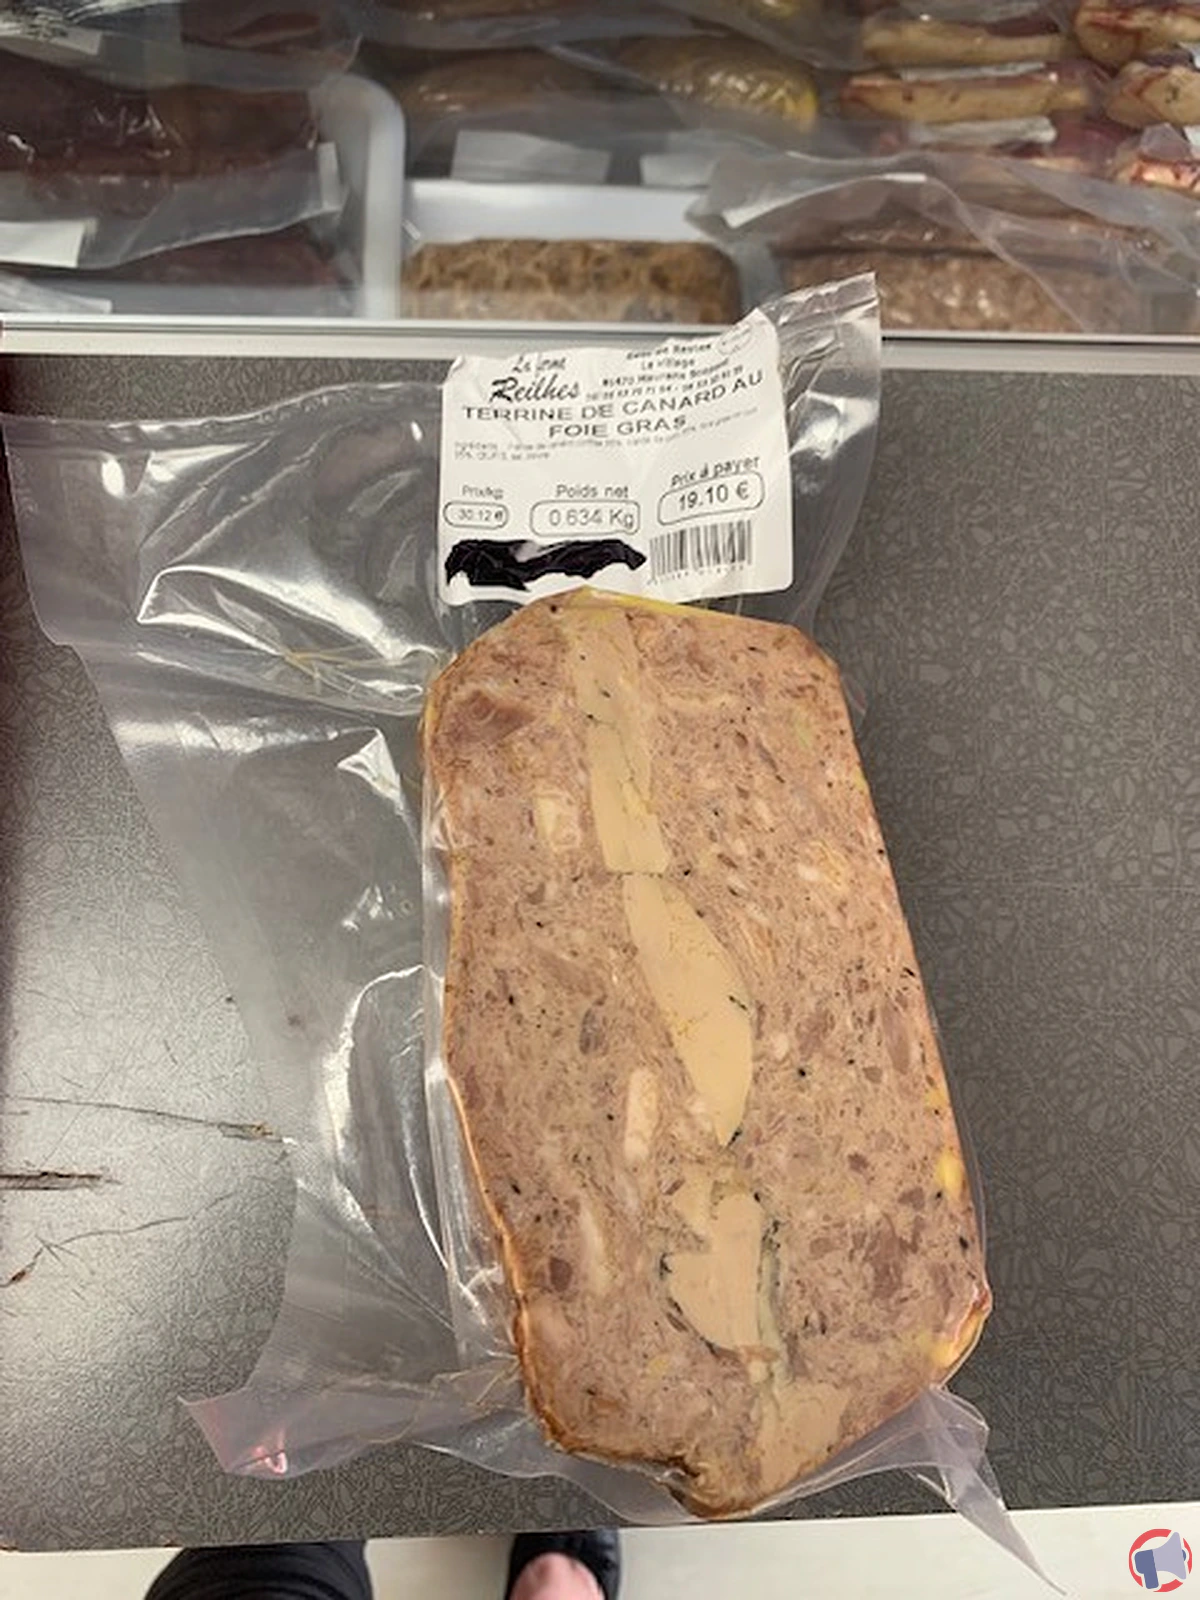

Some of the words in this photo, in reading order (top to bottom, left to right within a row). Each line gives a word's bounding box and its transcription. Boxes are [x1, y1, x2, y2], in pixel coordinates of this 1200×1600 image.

[462, 405, 574, 422] TERRINE
[581, 403, 615, 420] DE
[621, 384, 727, 416] CANARD
[731, 370, 764, 394] AU
[488, 373, 580, 403] Reilhes
[548, 423, 609, 439] FOIE
[616, 414, 687, 436] GRAS
[671, 470, 696, 488] Prix
[713, 455, 761, 479] payer
[555, 484, 598, 498] Poids
[604, 486, 629, 499] net
[678, 484, 729, 511] 19.10
[735, 480, 750, 501] €
[609, 508, 634, 530] Kg
